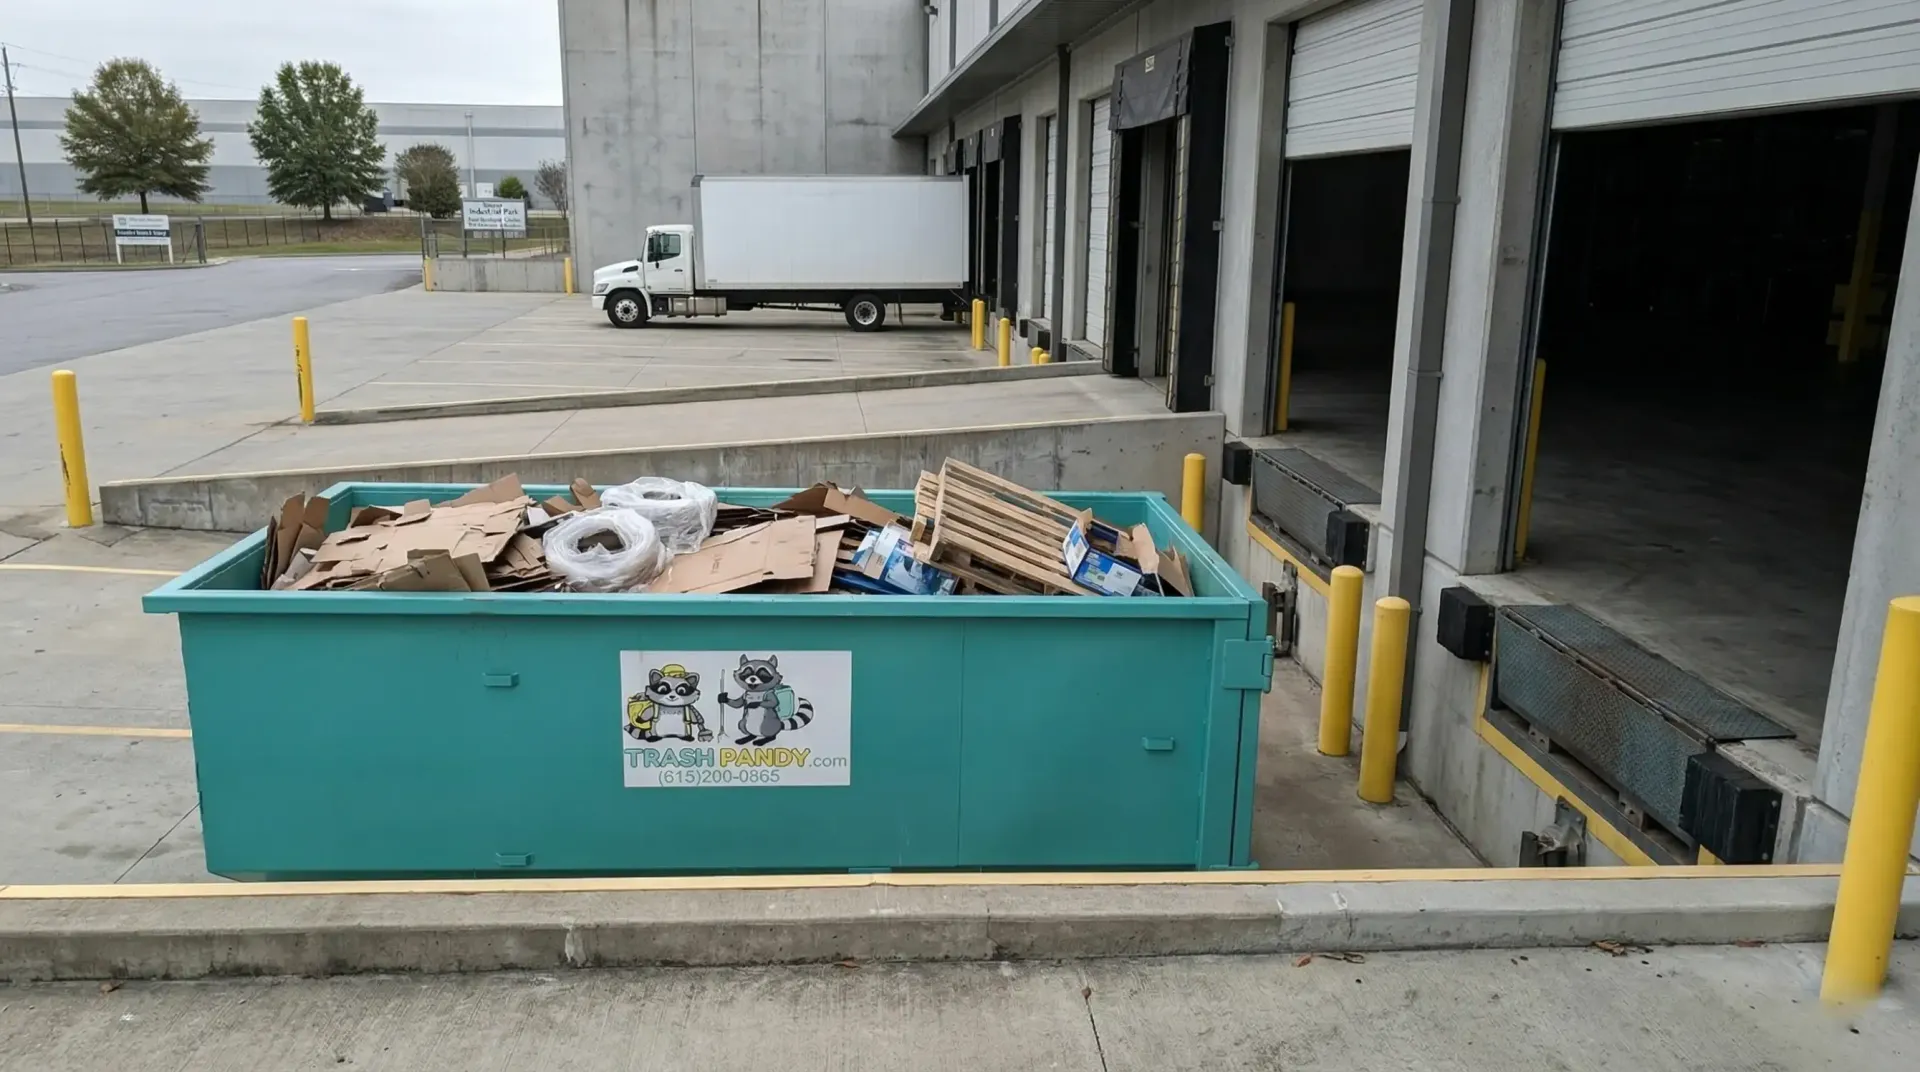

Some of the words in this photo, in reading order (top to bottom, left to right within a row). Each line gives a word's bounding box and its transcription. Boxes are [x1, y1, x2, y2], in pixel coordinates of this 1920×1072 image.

[503, 207, 518, 215] Park
[624, 748, 714, 767] TRASH
[658, 769, 780, 786] (615)200-0865
